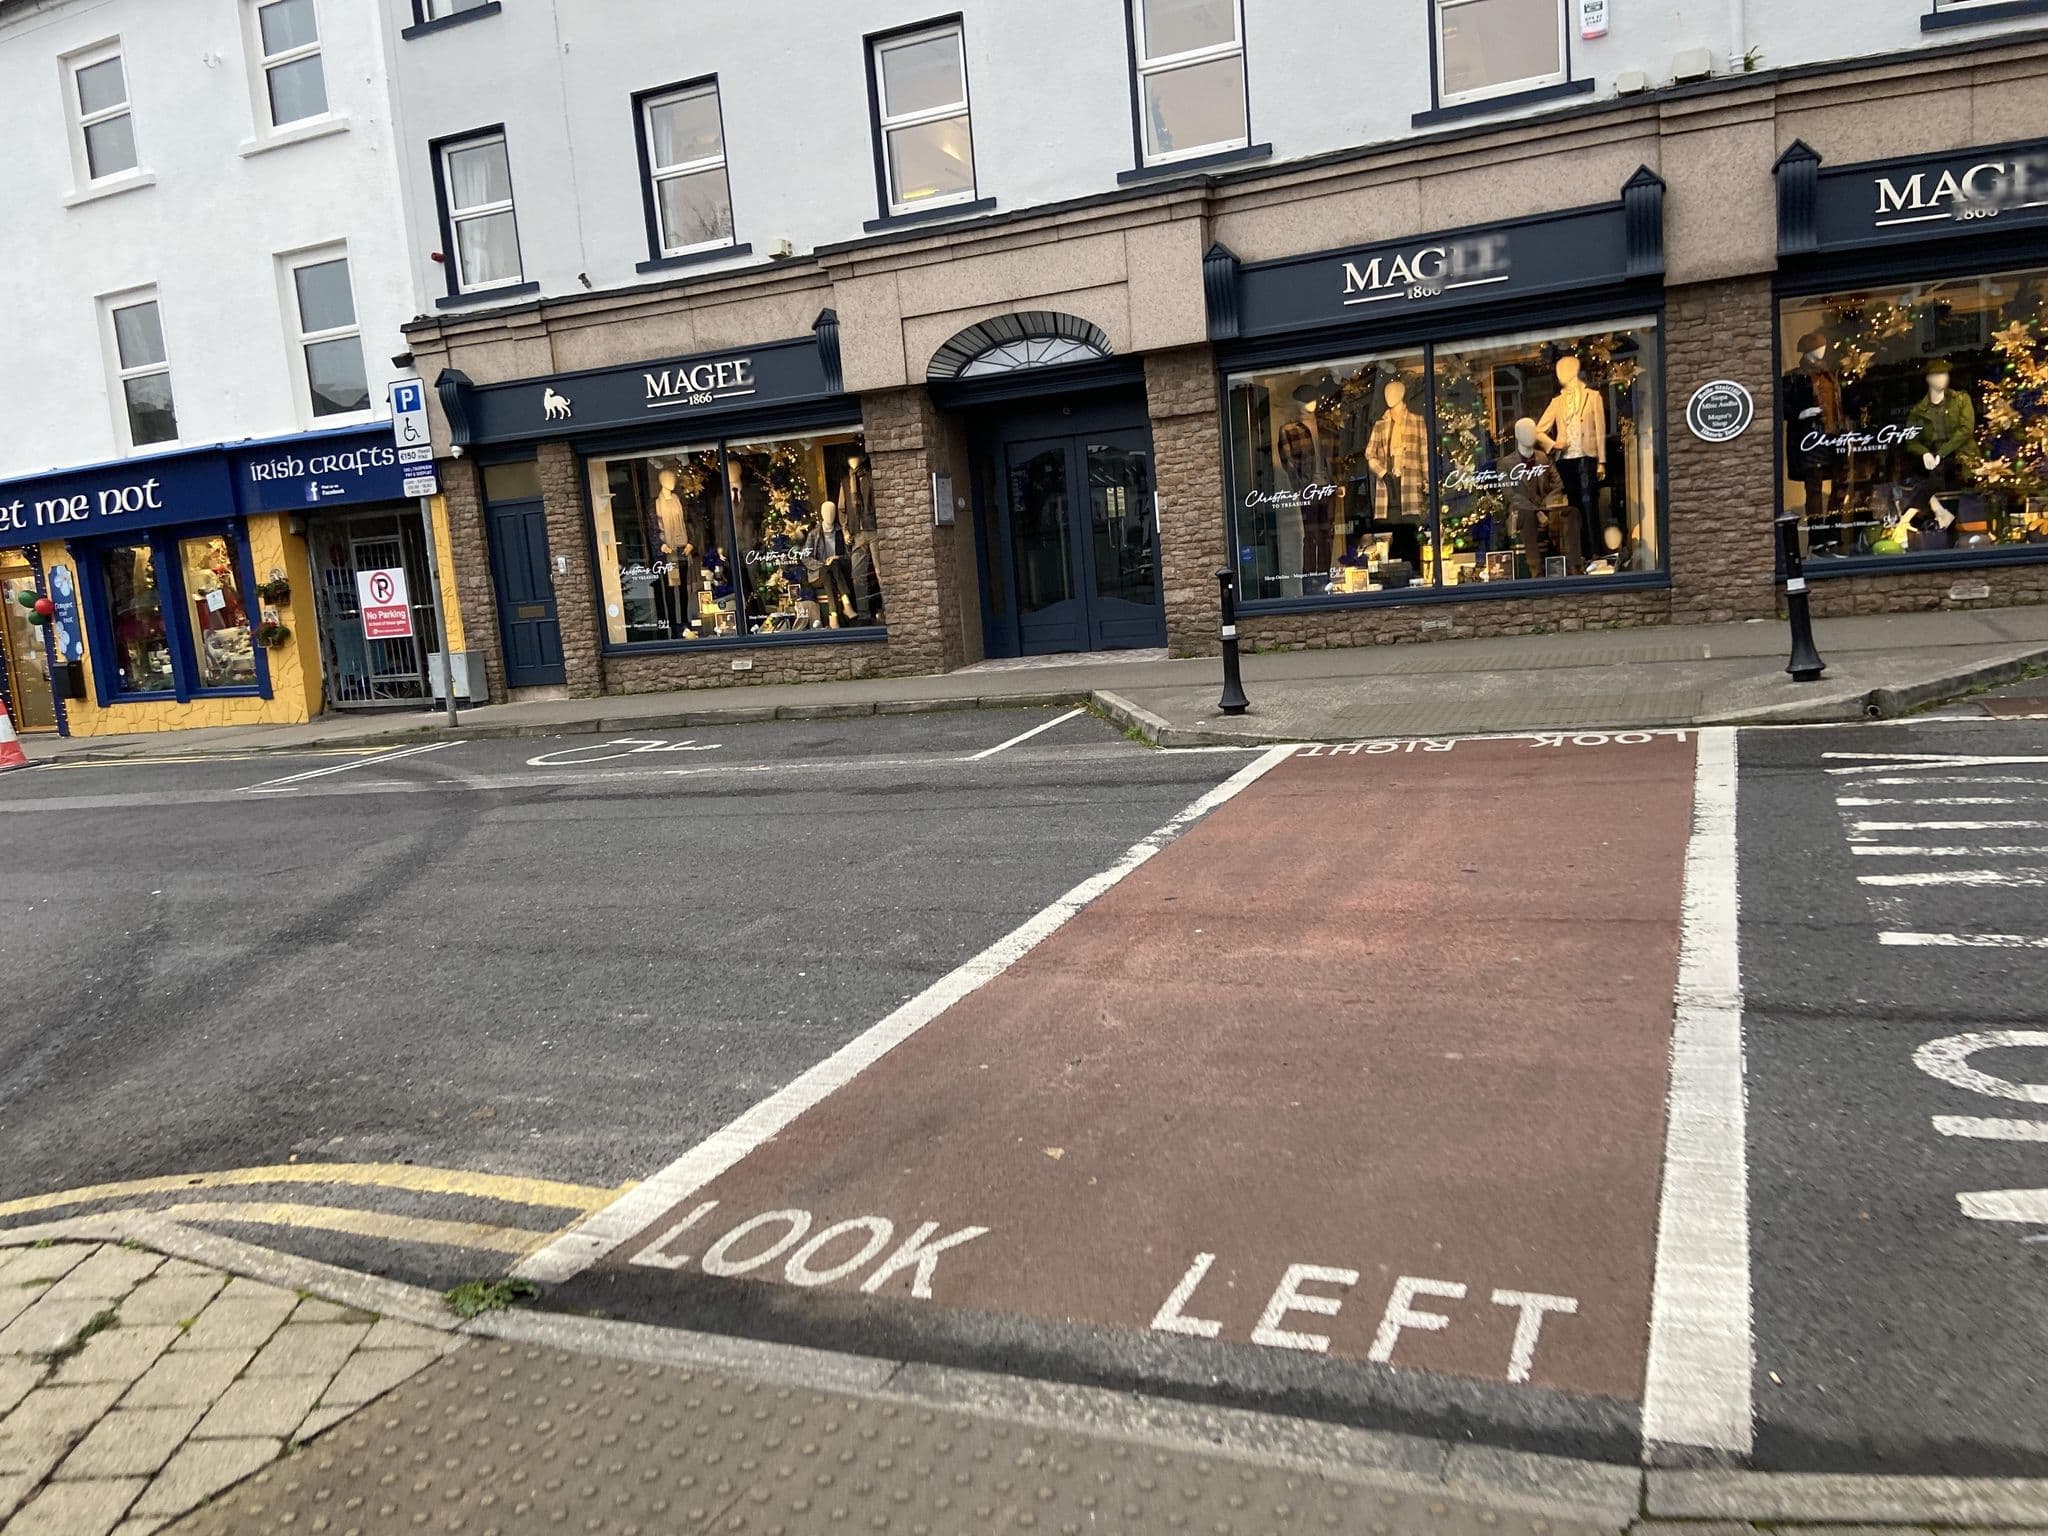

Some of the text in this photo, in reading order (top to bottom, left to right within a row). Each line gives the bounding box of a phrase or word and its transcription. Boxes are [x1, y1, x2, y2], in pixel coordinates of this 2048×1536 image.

[1875, 157, 2048, 213] MAG
[1342, 235, 1511, 294] MAG
[643, 358, 755, 398] MAGEE
[400, 388, 414, 411] P
[688, 392, 713, 406] 1866
[1800, 424, 1923, 452] Christmas Gifts
[1509, 462, 1550, 481] Gifts
[35, 494, 90, 526] me
[98, 478, 162, 516] not
[1245, 484, 1338, 508] Christmas Gifts
[1281, 500, 1312, 508] TREASURE
[366, 610, 406, 621] No Parking
[1296, 731, 1687, 757] LOOK RIGHT
[629, 1200, 1578, 1384] LOOK LEFT
